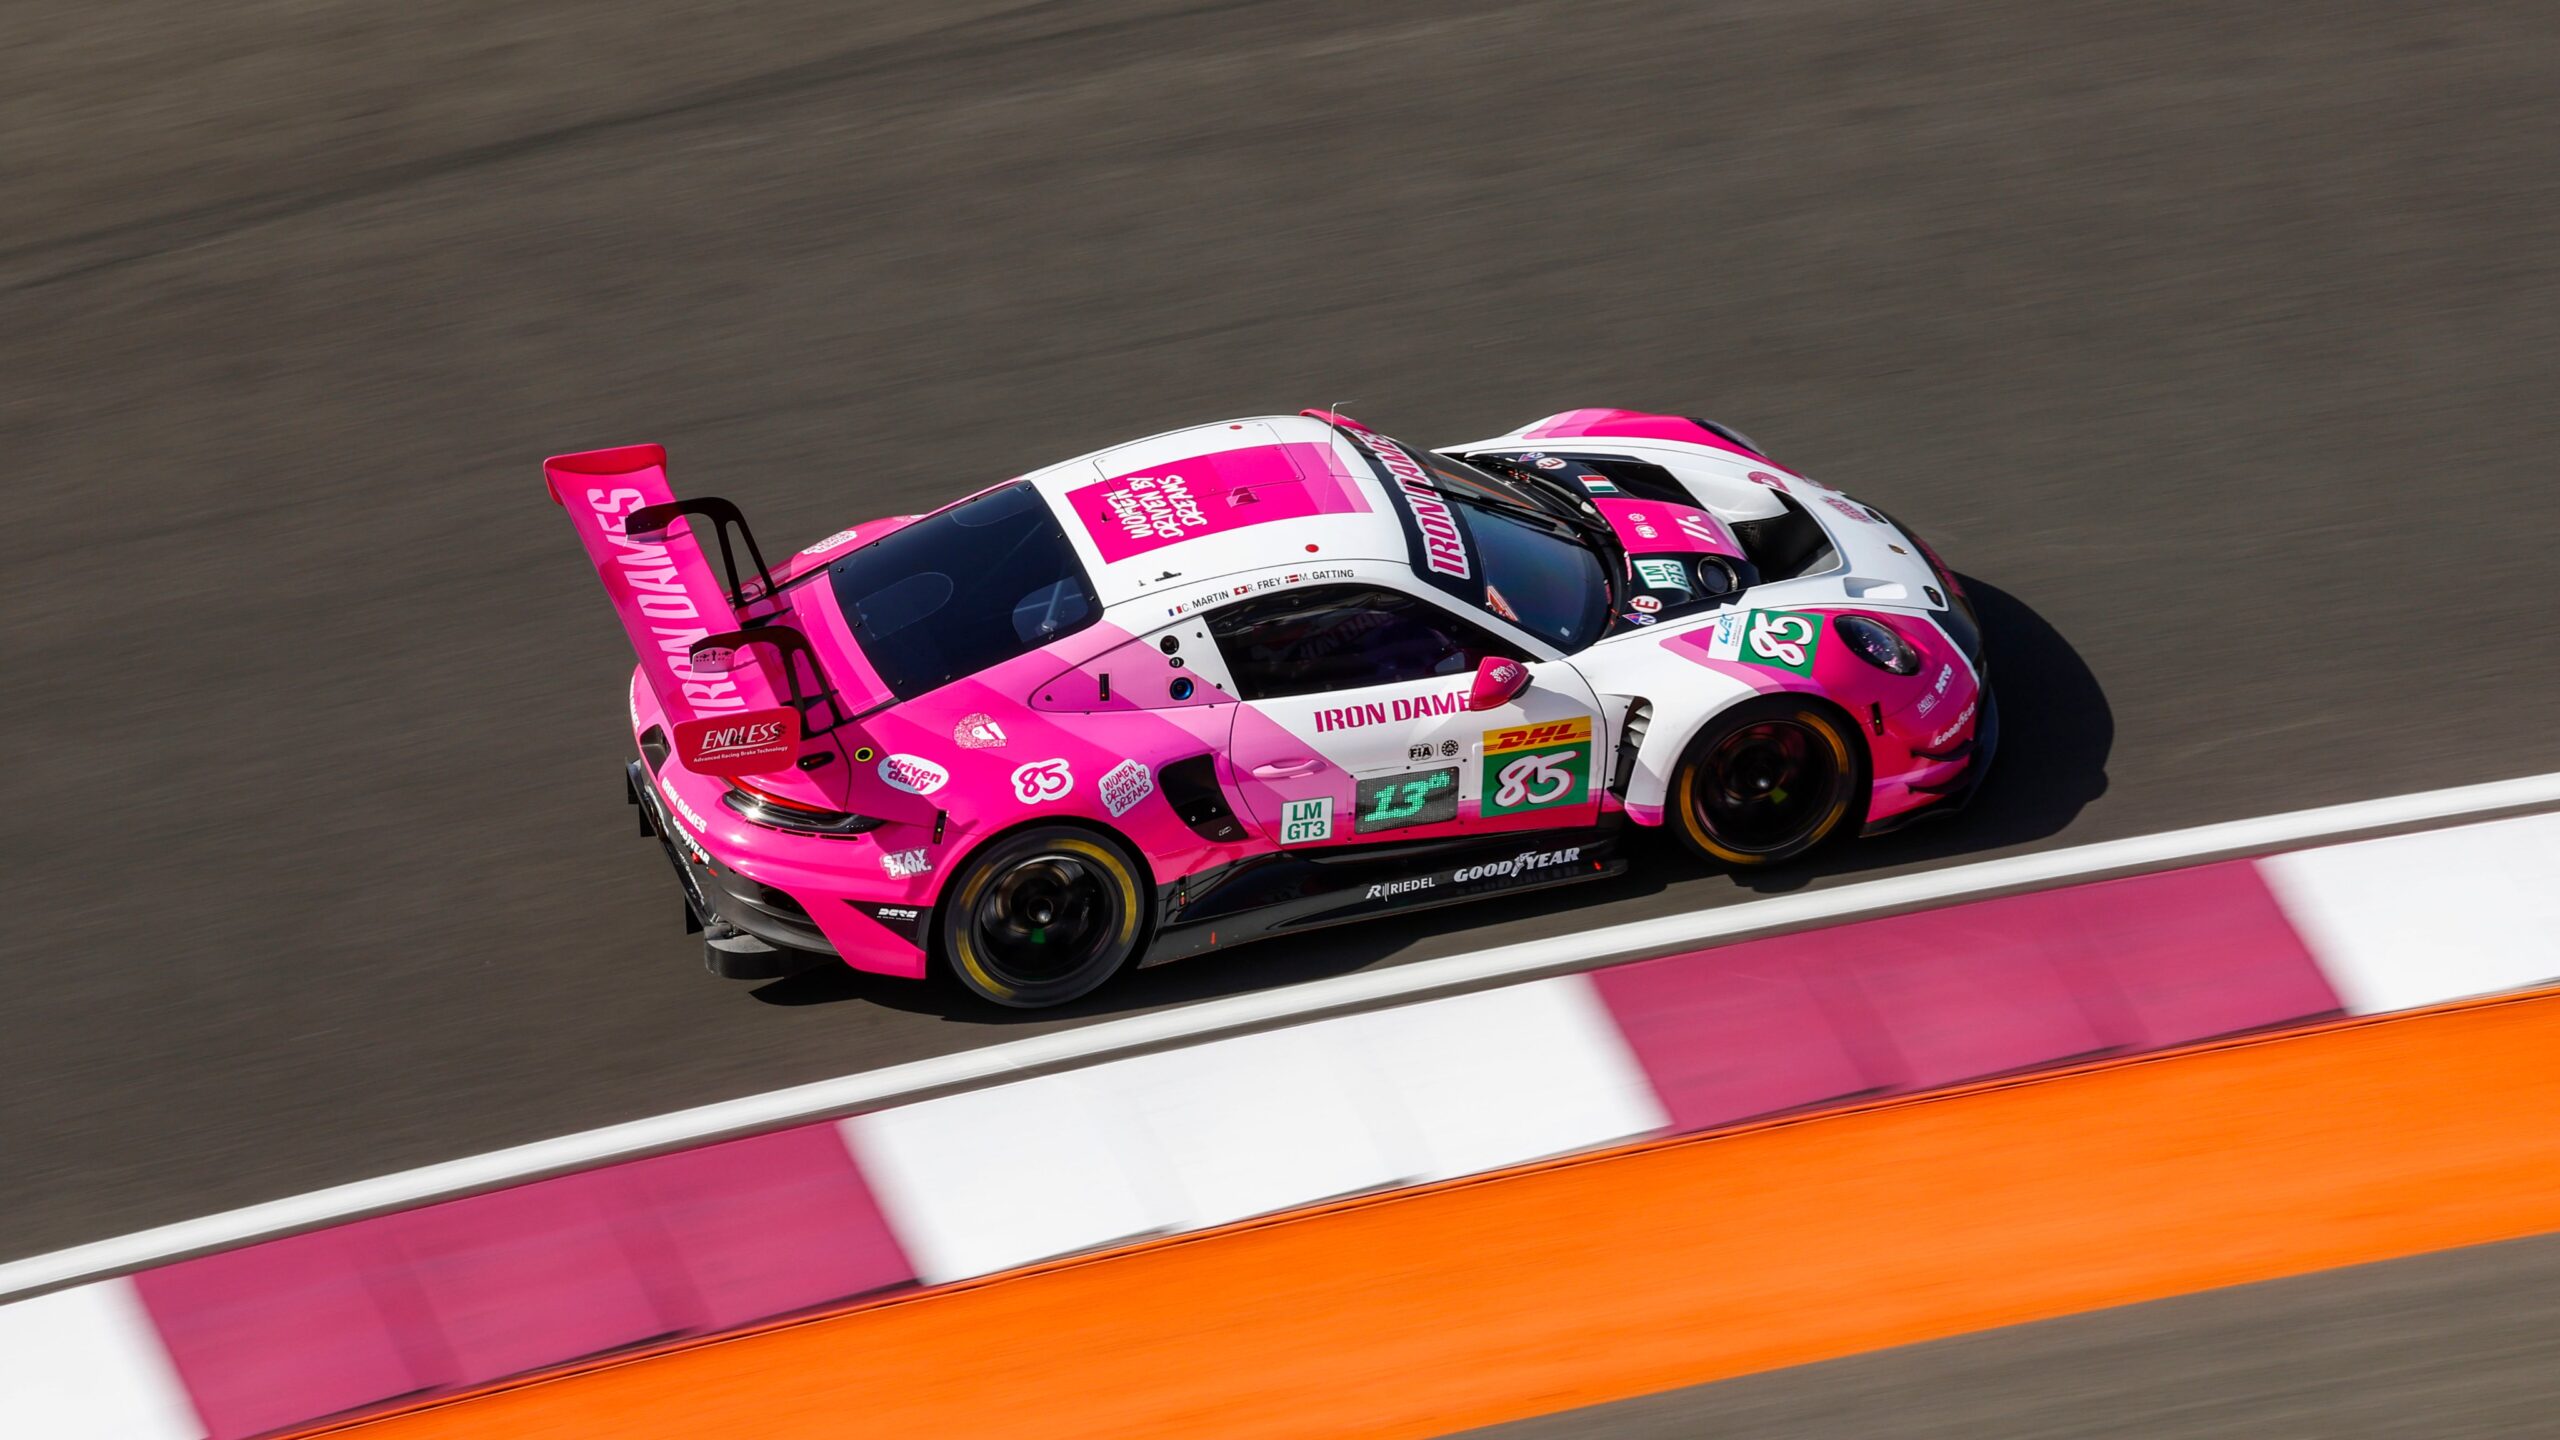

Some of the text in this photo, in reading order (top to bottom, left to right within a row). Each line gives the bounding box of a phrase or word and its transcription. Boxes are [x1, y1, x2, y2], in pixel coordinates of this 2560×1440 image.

[1100, 488, 1155, 539] WOMEN
[1125, 477, 1185, 539] DRIVEN BY
[1156, 474, 1208, 527] DREAMS
[1406, 495, 1469, 579] IRON
[1258, 577, 1281, 590] FREY
[1312, 569, 1355, 580] GATTING
[1642, 565, 1668, 582] LM
[1663, 563, 1689, 587] GT3
[1192, 590, 1229, 608] MARTIN
[1748, 611, 1814, 668] 85
[1313, 690, 1472, 733] IRON DAME
[702, 721, 781, 750] ENDLESS
[1498, 723, 1578, 750] DHL
[694, 754, 721, 763] Advanced
[757, 745, 789, 754] Technology
[1410, 746, 1432, 760] FIA
[887, 759, 942, 783] driven
[888, 768, 930, 791] daily
[1016, 761, 1069, 800] 85
[1102, 763, 1137, 791] WOMEN
[1494, 750, 1580, 807] 85
[1105, 768, 1148, 806] DRIVEN BY
[1114, 782, 1150, 812] DREAMS
[677, 798, 707, 833] DAMES
[1292, 801, 1322, 821] LM
[1287, 821, 1326, 841] GT3
[883, 849, 926, 868] STAY
[1453, 847, 1581, 883] GOODYEAR
[1390, 877, 1436, 895] RIEDEL
